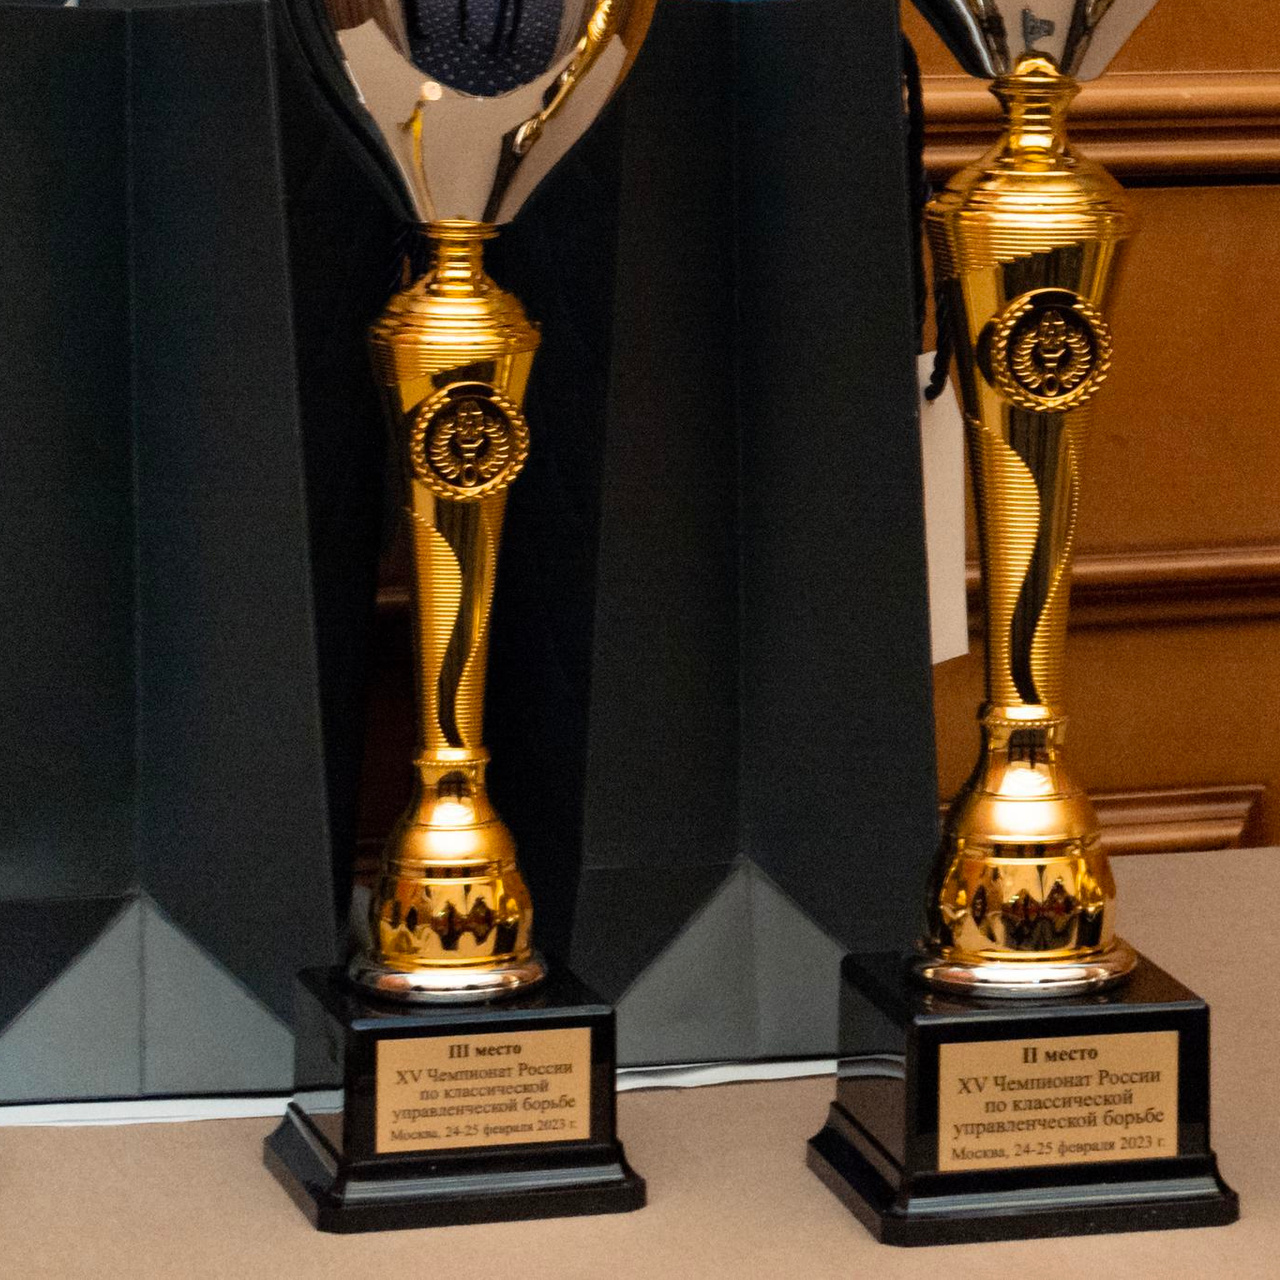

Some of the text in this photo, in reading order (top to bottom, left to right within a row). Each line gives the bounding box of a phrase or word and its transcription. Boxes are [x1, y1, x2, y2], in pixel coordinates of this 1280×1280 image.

[448, 1044, 522, 1059] III место
[1022, 1047, 1099, 1064] II место
[396, 1062, 573, 1085] XV Чемпионат России
[957, 1070, 1161, 1094] XV Чемпионат России
[420, 1080, 549, 1101] по классической
[392, 1095, 576, 1124] управленческой борьбе
[984, 1090, 1134, 1114] по классической
[445, 1124, 480, 1137] 24-25
[483, 1122, 534, 1137] февраля
[537, 1119, 566, 1131] 2023
[953, 1108, 1165, 1139] управленческой борьбе
[1014, 1142, 1054, 1156] 24-25
[1057, 1141, 1115, 1156] февраля
[1120, 1136, 1153, 1150] 2023
